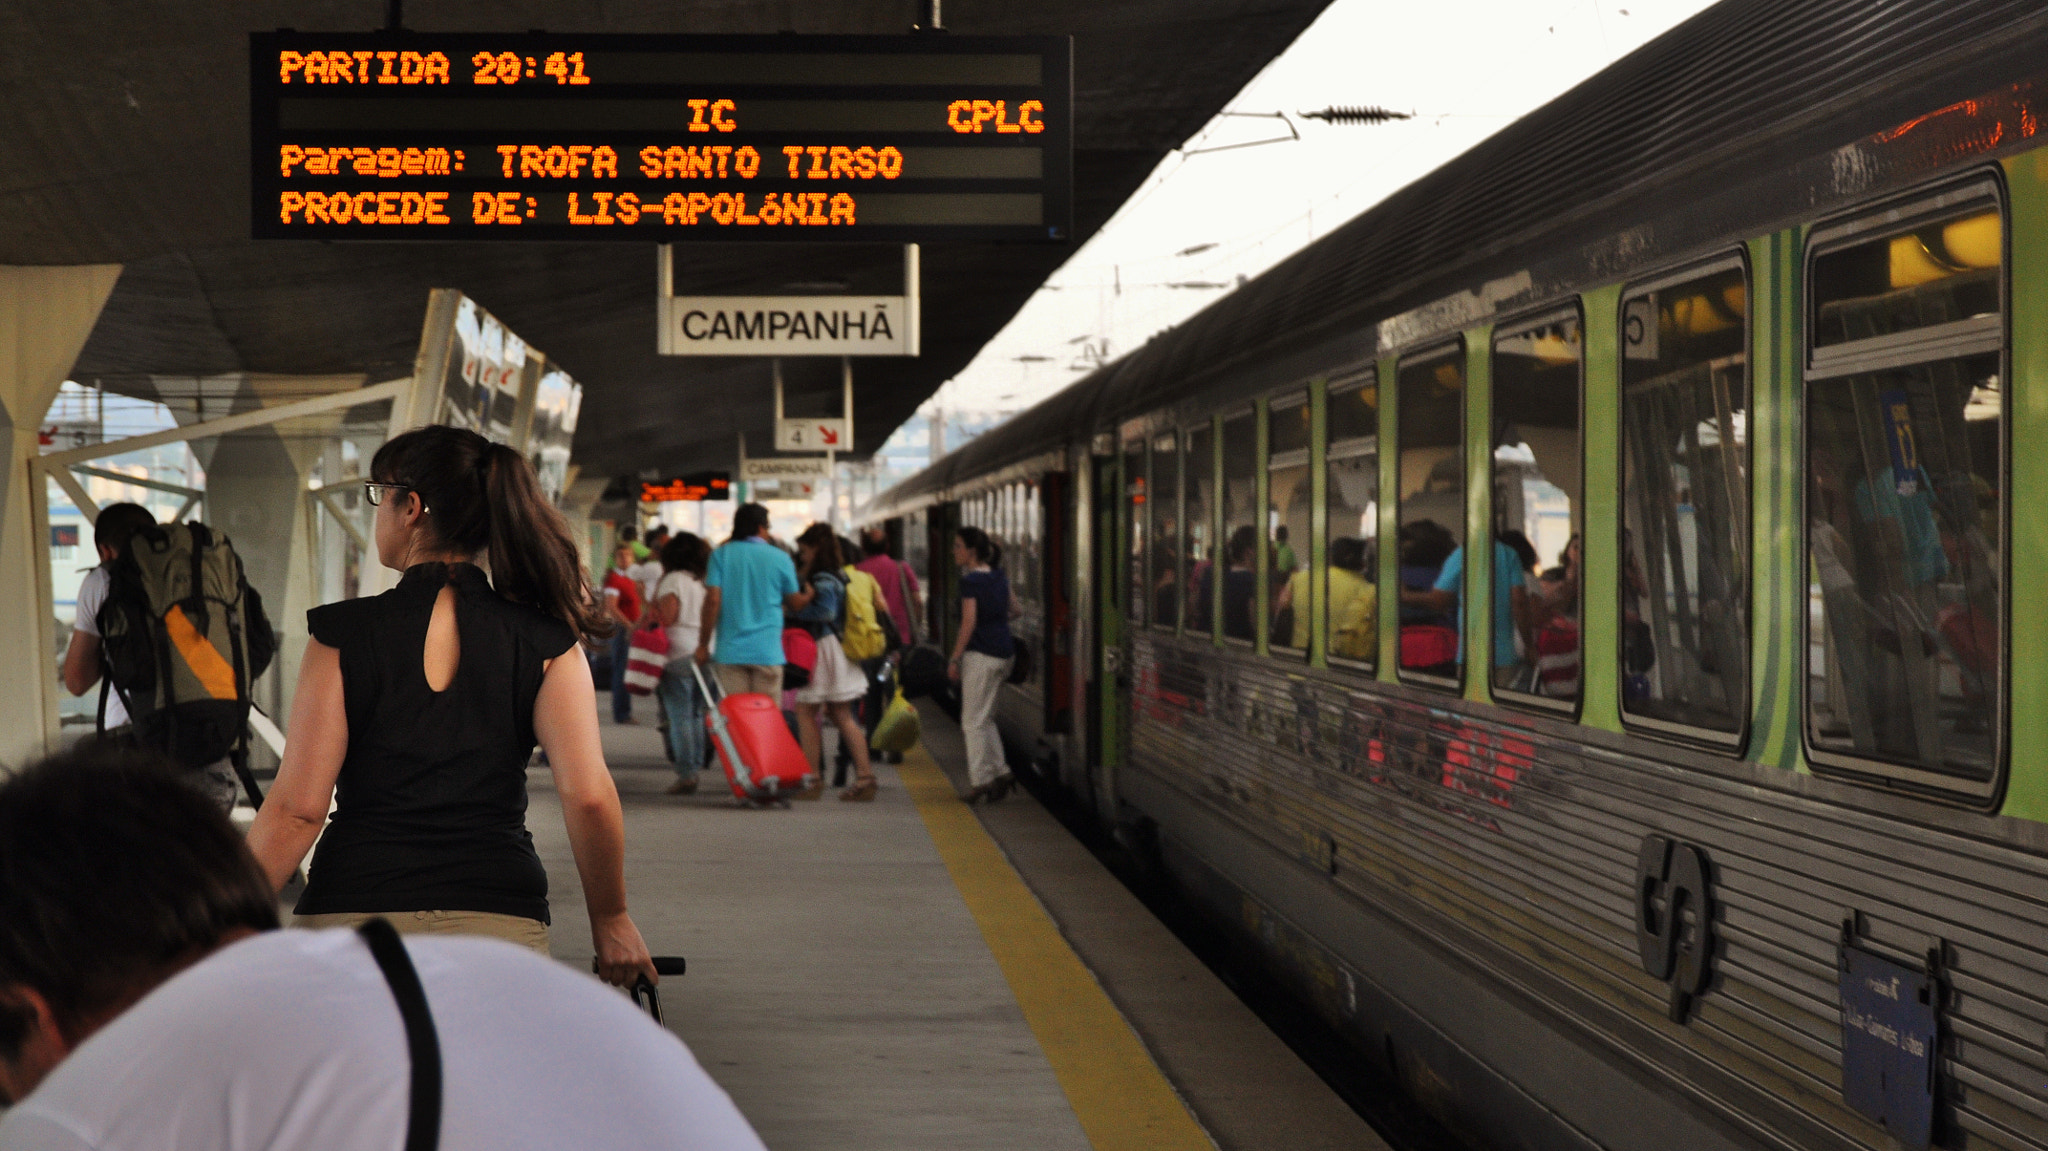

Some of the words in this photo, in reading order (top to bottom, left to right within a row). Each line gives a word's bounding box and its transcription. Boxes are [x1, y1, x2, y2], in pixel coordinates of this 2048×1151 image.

[279, 50, 451, 85] PARTIDA
[471, 51, 592, 86] 20:41
[686, 98, 737, 133] IC
[946, 99, 1045, 134] CPLC
[280, 144, 466, 178] Paragem:
[496, 144, 619, 179] TROFA
[639, 145, 761, 179] SANTO
[782, 145, 904, 180] TIRSO
[279, 191, 451, 225] PROCEDE
[471, 191, 538, 225] DE:
[681, 304, 894, 341] CAMPANHÃ
